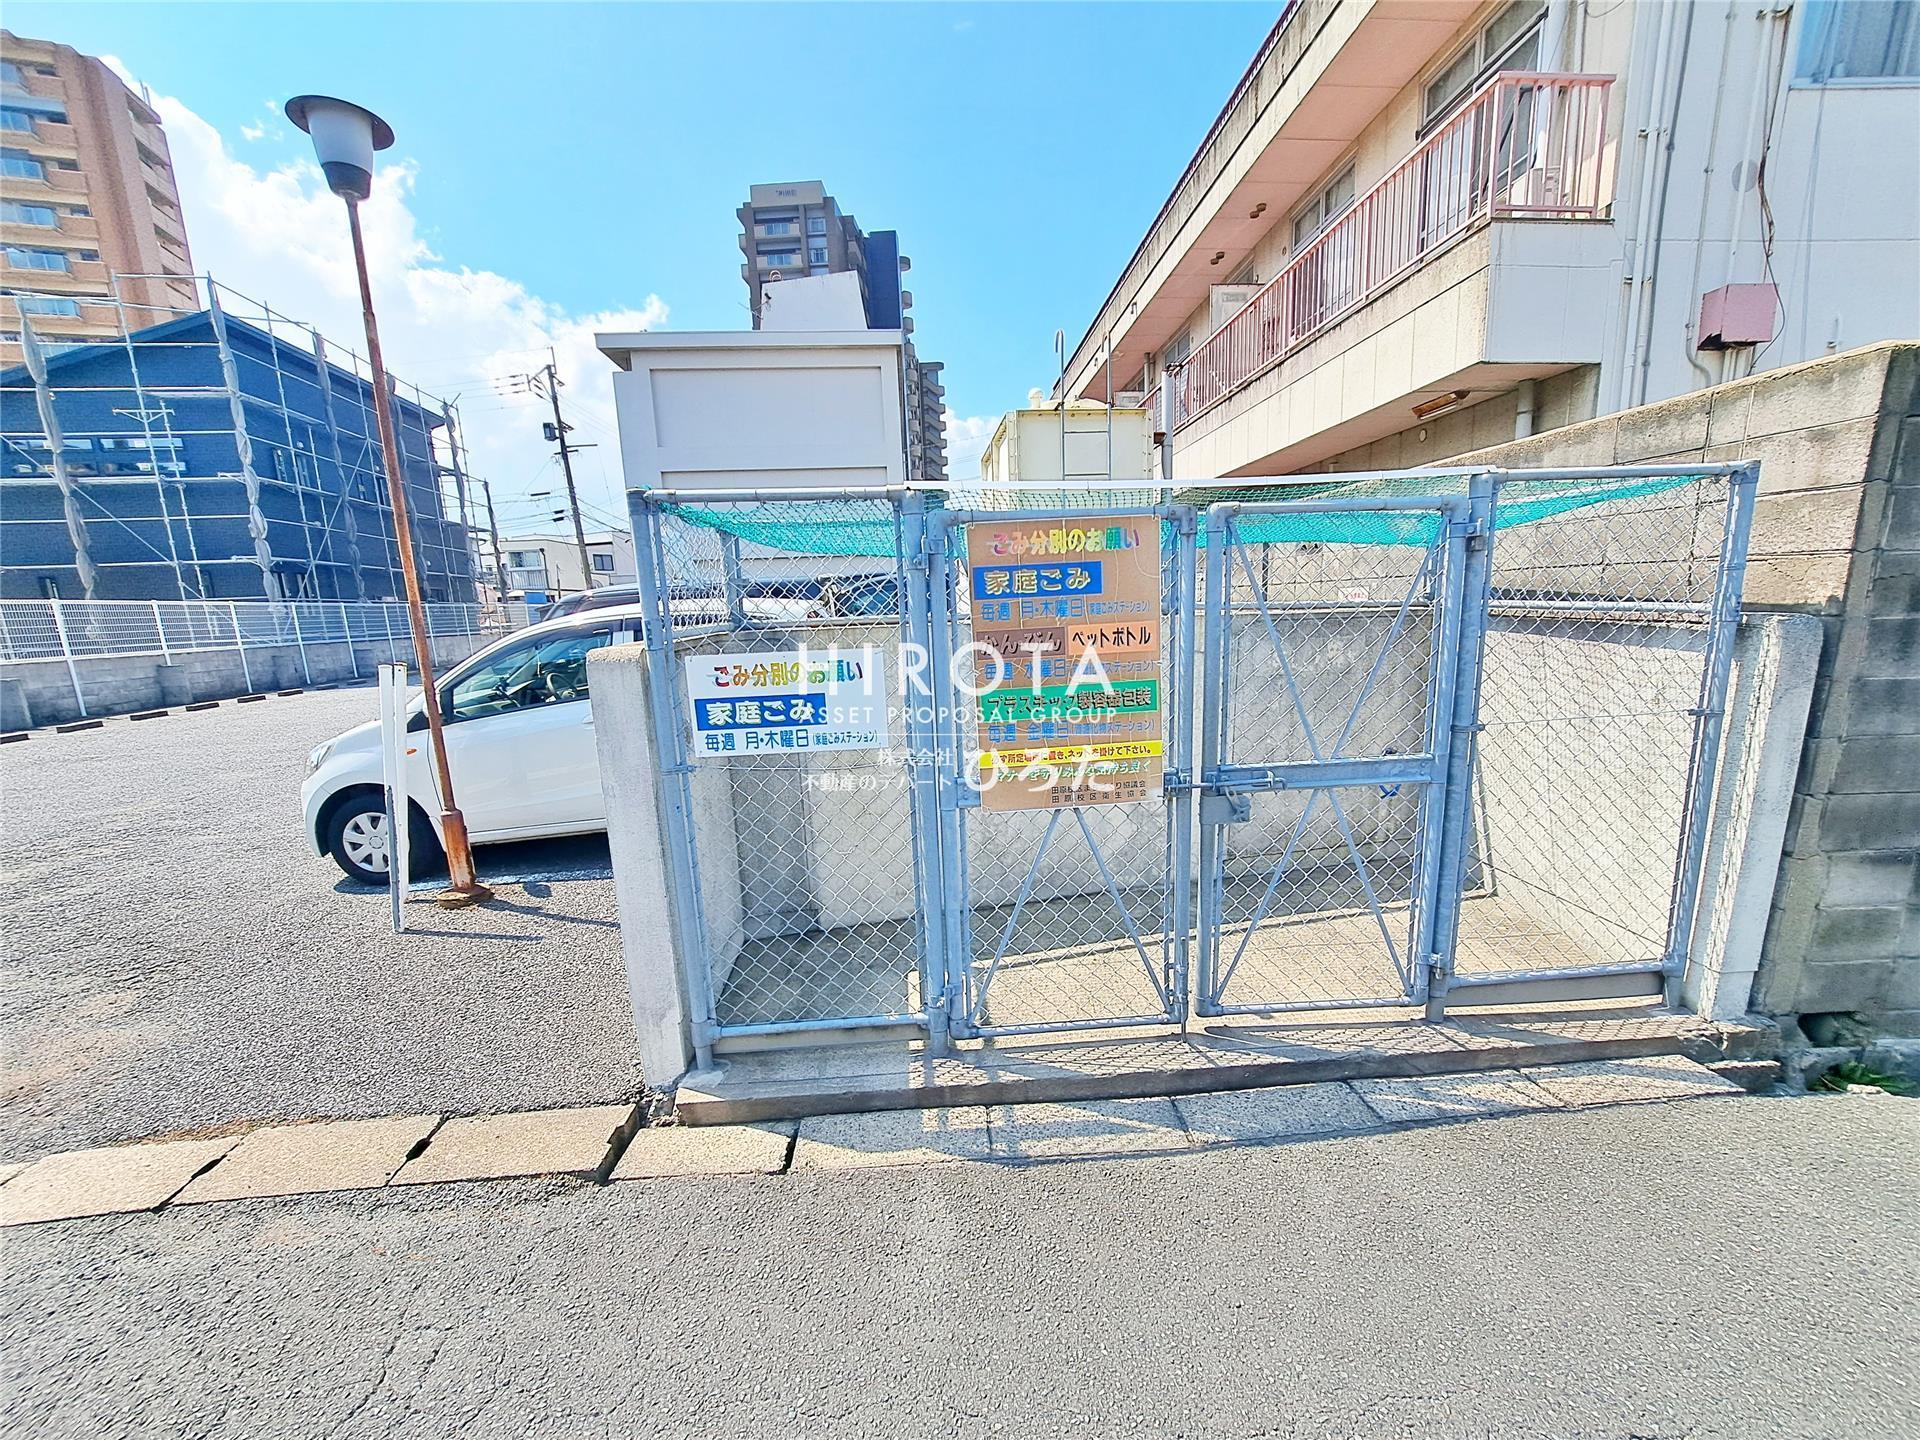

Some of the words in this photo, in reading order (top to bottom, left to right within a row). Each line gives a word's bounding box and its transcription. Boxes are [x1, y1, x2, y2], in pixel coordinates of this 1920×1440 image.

[992, 526, 1140, 556] ごみ分別のお願い
[984, 567, 1091, 596] 家庭ごみ
[981, 602, 1012, 622] 毎週
[1072, 626, 1151, 648] ペットボトル
[713, 659, 864, 688] ごみ分別のお願い
[706, 699, 816, 725] 家庭ごみ
[705, 732, 735, 751] 毎週
[987, 722, 1017, 743] 毎週
[1027, 720, 1069, 742] 金曜日
